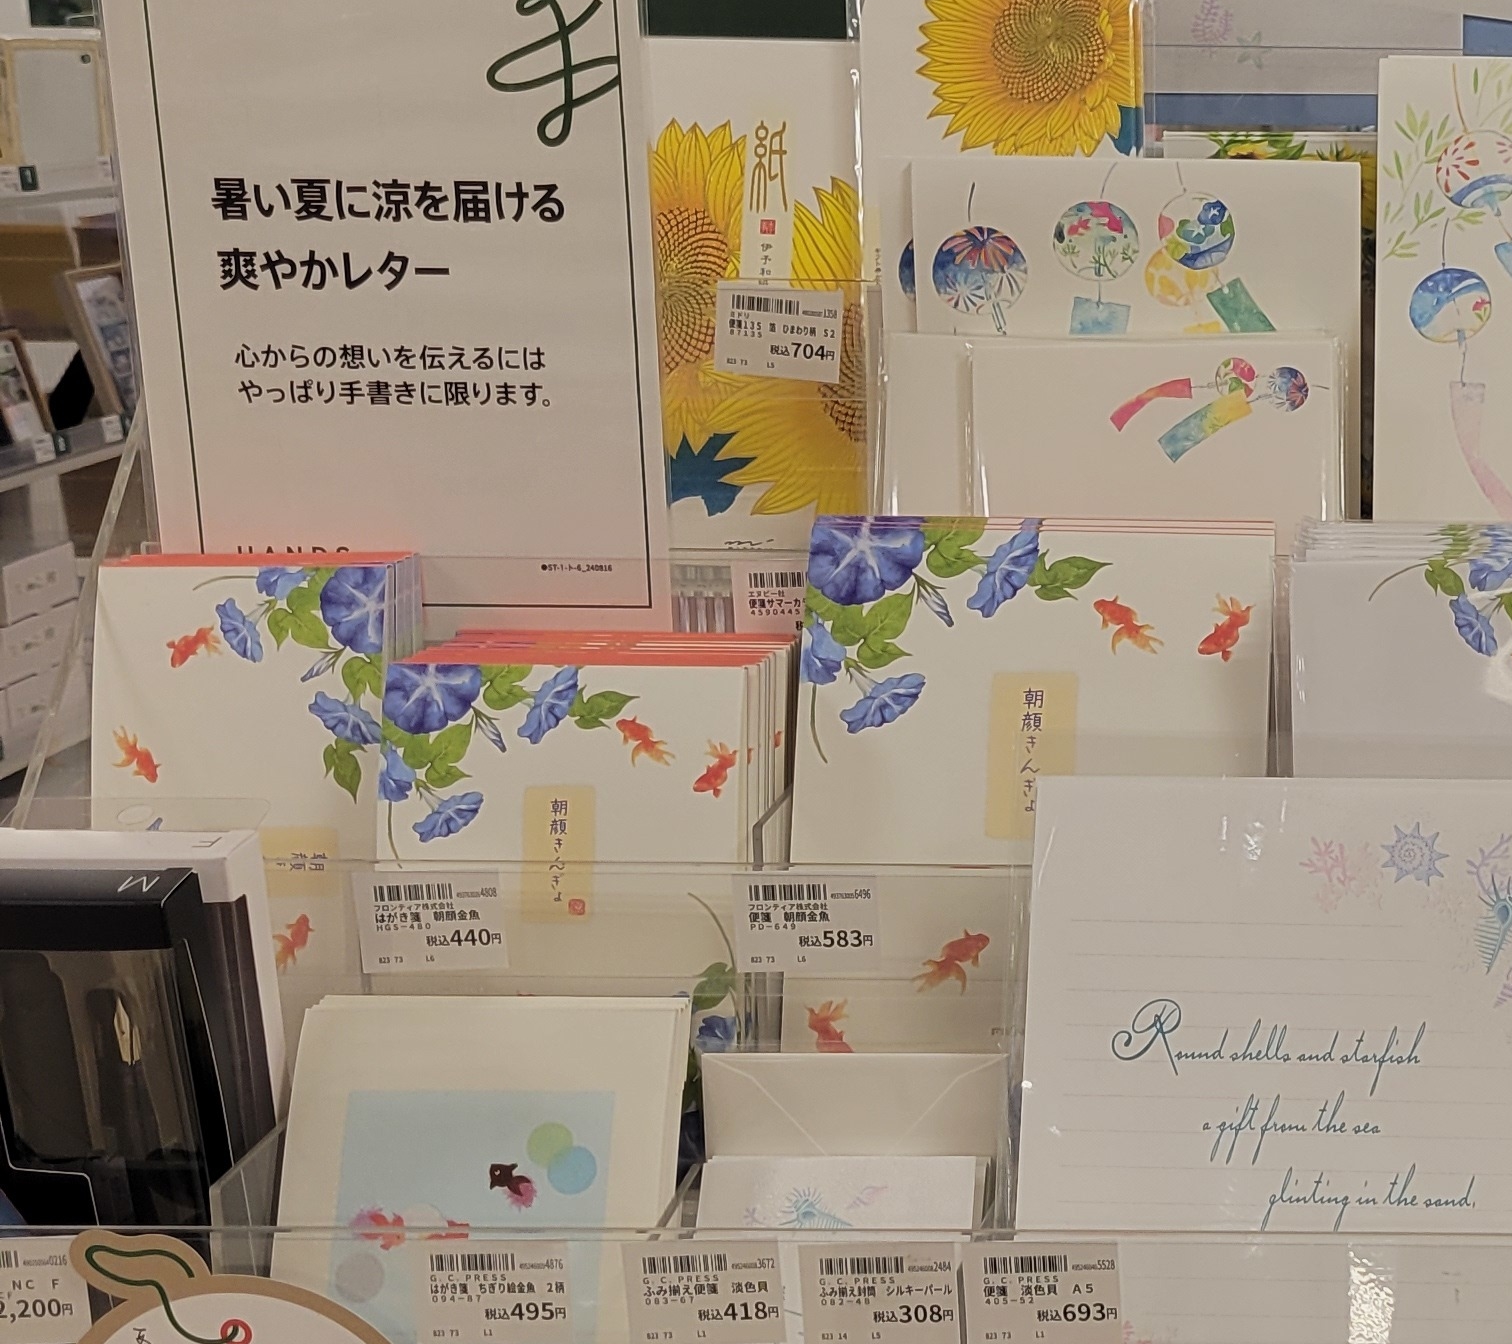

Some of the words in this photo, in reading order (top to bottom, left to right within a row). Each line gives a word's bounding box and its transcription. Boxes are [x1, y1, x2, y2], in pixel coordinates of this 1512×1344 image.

[211, 176, 567, 224] 暑い夏に涼を届ける
[217, 248, 452, 291] 爽やかレター
[234, 344, 547, 372] 心からの想いを伝えるには
[769, 342, 836, 362] 税込704円
[238, 379, 552, 408] やっぱり手書きに限ります。
[1020, 687, 1045, 813] 朝顔きんぎょ
[549, 797, 568, 903] 朝顔きんぎょ
[374, 901, 455, 912] フロンティア株式会社
[433, 909, 481, 922] 朝顔金魚
[748, 902, 829, 911] フロンティア株式会社
[783, 910, 831, 923] 朝顔金魚
[426, 928, 502, 947] 税込440円
[798, 929, 874, 948] 税込583円
[1111, 998, 1224, 1076] Round
[1231, 1017, 1292, 1062] shells
[1296, 1030, 1338, 1062] and
[1340, 1020, 1427, 1097] starfish
[1202, 1121, 1212, 1131] a
[1209, 1092, 1260, 1165] gift
[1251, 1093, 1308, 1166] from
[1311, 1089, 1348, 1134] the
[1351, 1125, 1382, 1134] sea
[1260, 1166, 1350, 1232] glinting
[1355, 1180, 1379, 1207] in
[1383, 1162, 1419, 1207] the
[478, 1281, 536, 1294] ちぎり絵金魚
[1020, 1284, 1059, 1297] 淡色貝
[484, 1301, 567, 1321] 税込495円
[697, 1301, 780, 1321] 税込418円
[872, 1304, 954, 1324] 税込308円
[1036, 1302, 1118, 1322] 税込693円
